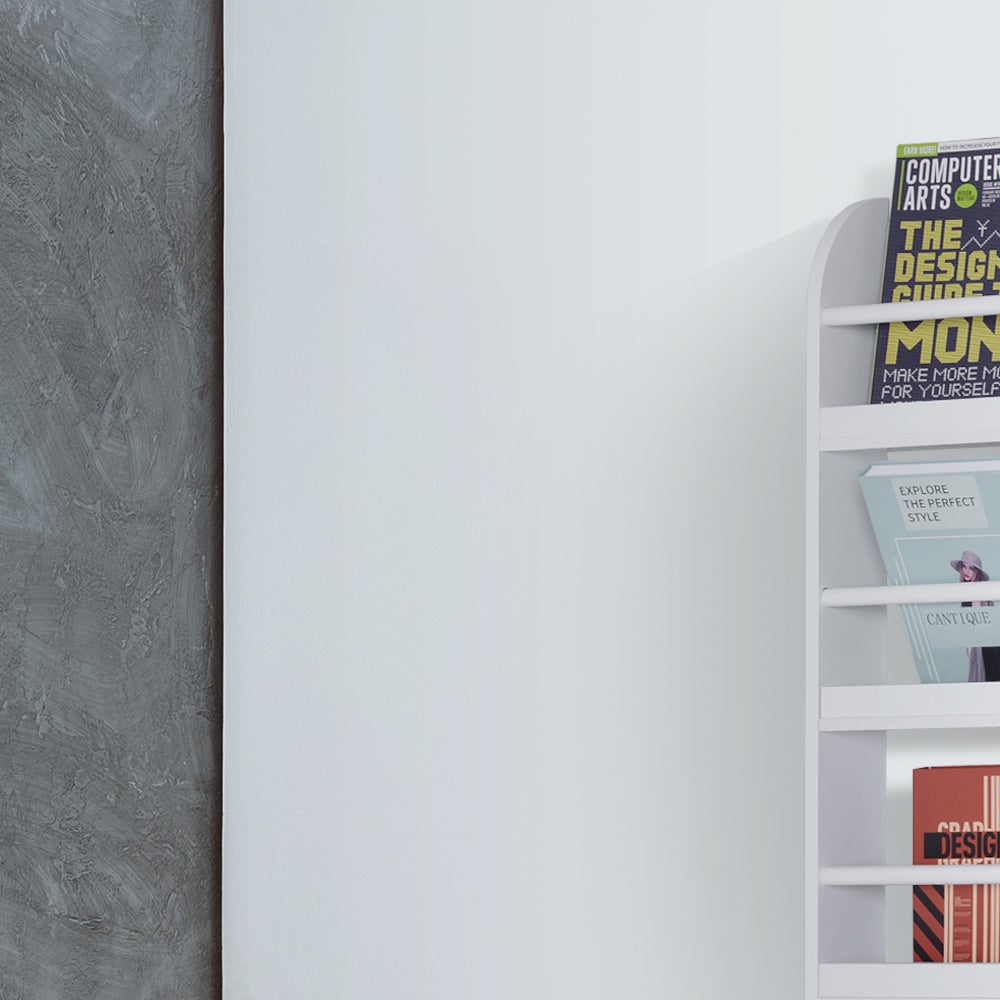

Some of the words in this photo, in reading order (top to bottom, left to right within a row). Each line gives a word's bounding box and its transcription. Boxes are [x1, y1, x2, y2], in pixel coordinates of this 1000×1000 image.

[903, 184, 952, 211] ARTS
[900, 219, 964, 251] THE
[883, 368, 928, 383] MAKE
[933, 366, 978, 382] MORE
[881, 384, 913, 399] FOR
[919, 382, 1000, 398] YOURSELF
[899, 484, 949, 496] EXPLORE
[903, 499, 926, 509] THE
[927, 496, 975, 509] PERFECT
[907, 511, 941, 523] STYLE
[926, 610, 992, 627] CANTIQUE
